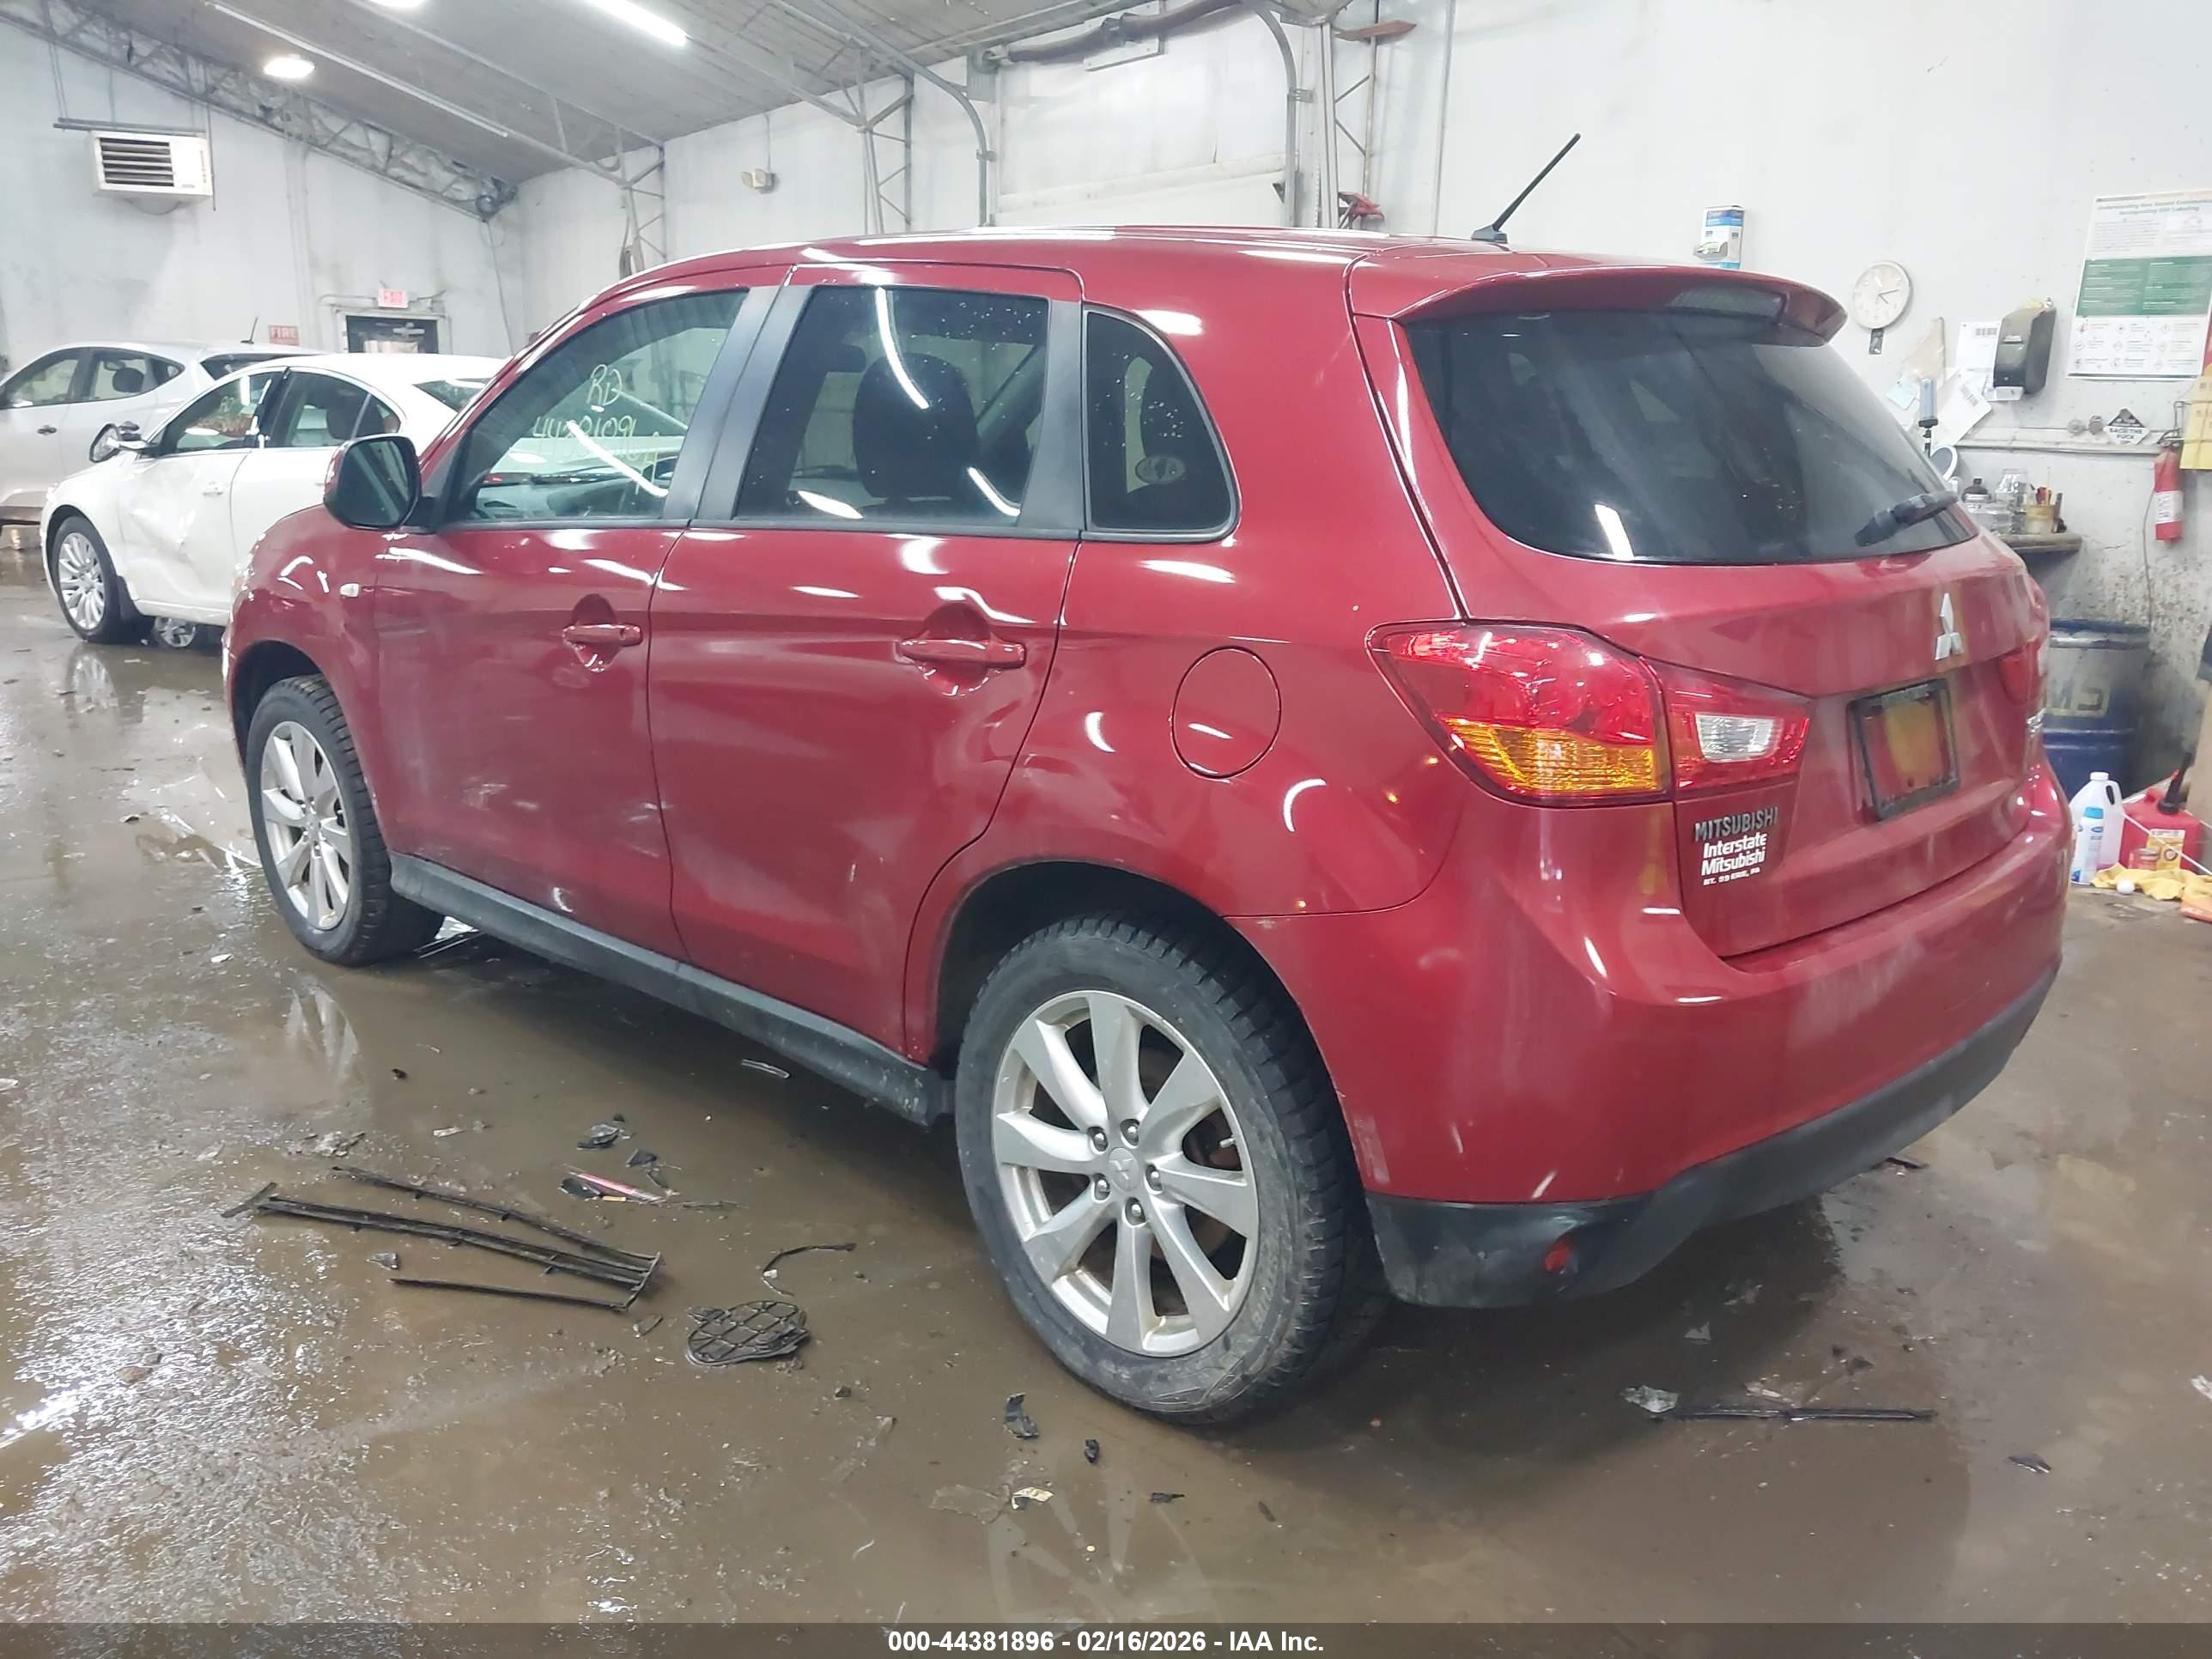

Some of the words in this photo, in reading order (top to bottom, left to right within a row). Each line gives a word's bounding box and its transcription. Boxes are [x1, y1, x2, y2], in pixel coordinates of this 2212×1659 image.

[270, 326, 297, 338] FIRE
[1694, 807, 1778, 842] MITSUBISHI
[1703, 832, 1767, 858] Interstate
[1701, 847, 1766, 876] Mitsubishi
